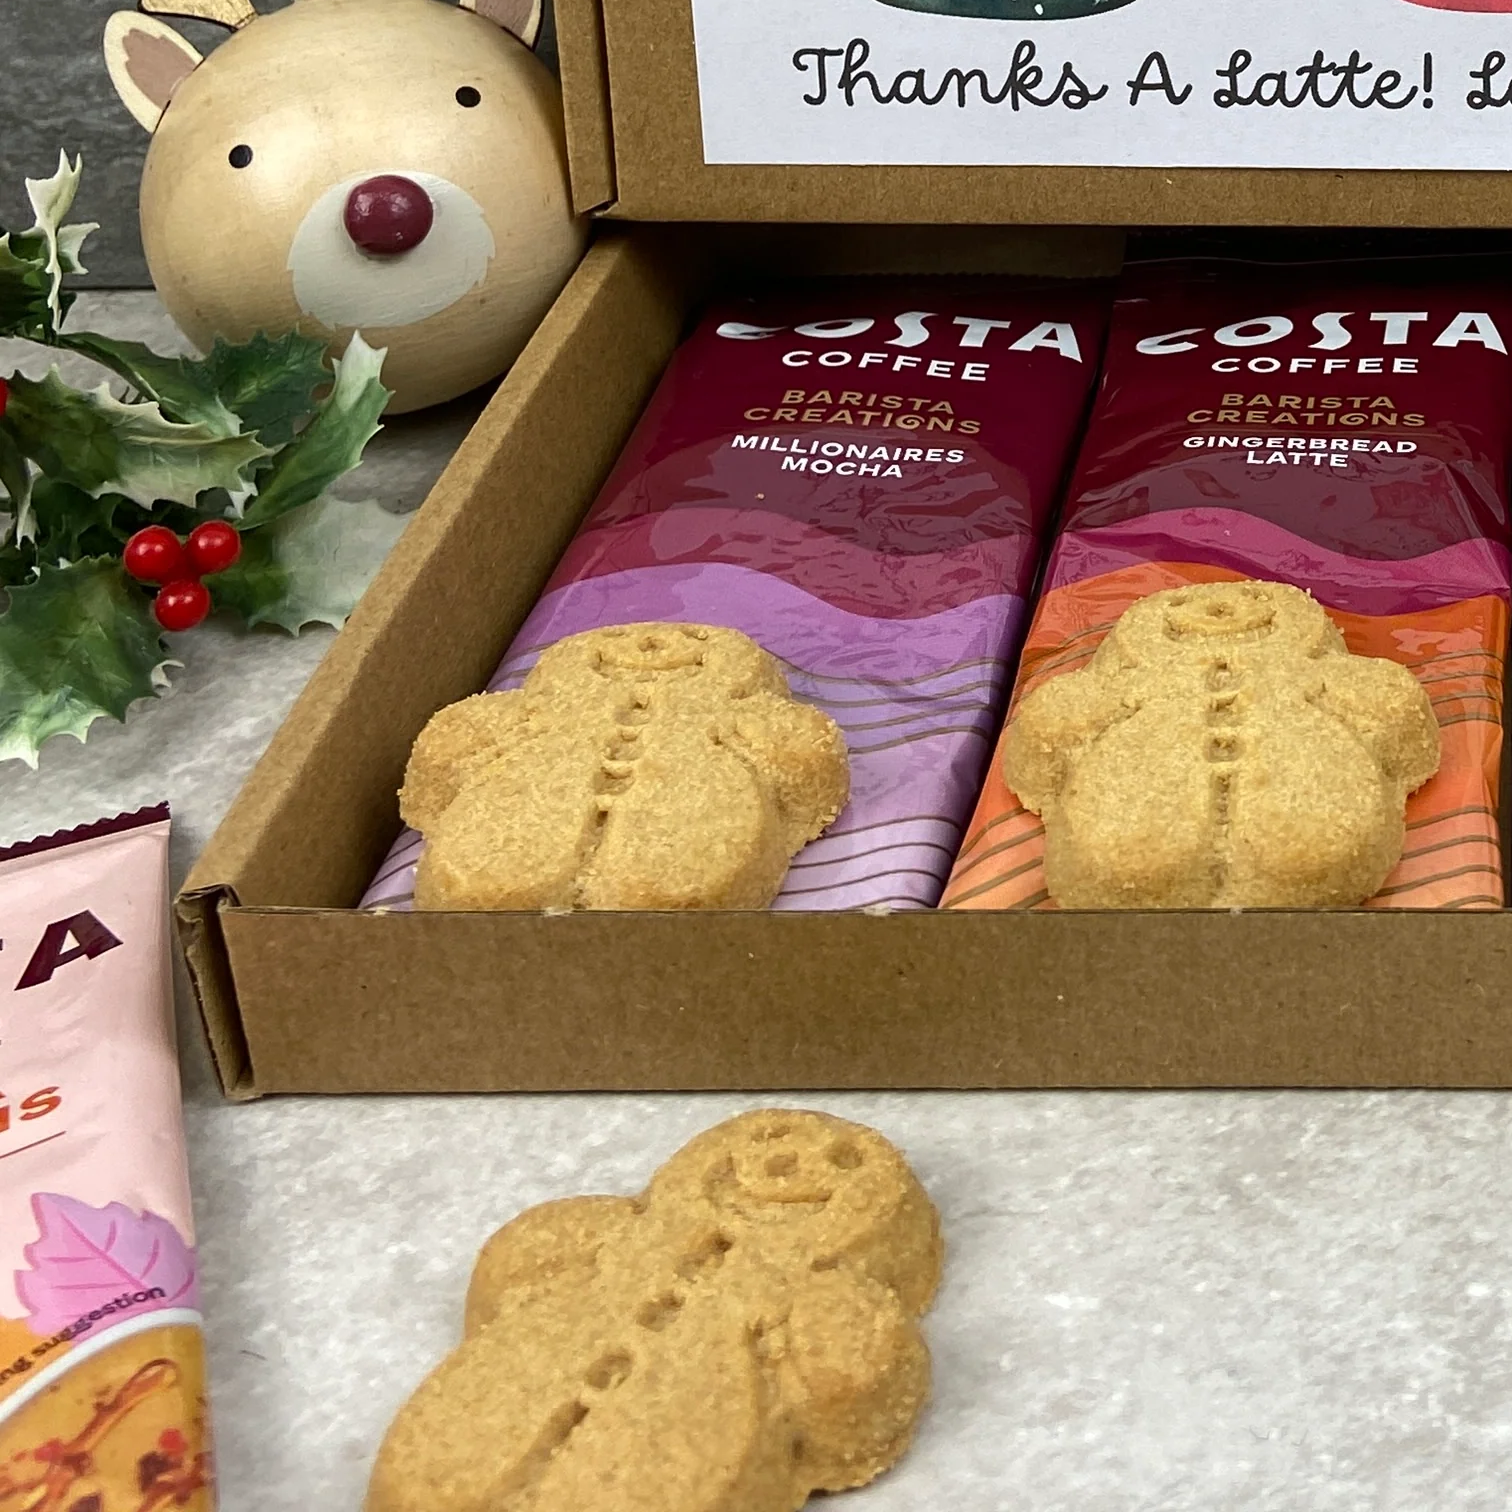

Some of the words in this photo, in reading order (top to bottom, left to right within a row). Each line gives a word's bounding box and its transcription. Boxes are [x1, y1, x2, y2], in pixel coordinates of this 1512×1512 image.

[792, 38, 1109, 111] Thanks
[1126, 50, 1192, 107] A
[1213, 49, 1434, 111] Latte!
[716, 311, 1083, 363] COSTA
[1135, 311, 1508, 356] COSTA
[782, 350, 990, 382] COFFEE
[1211, 357, 1419, 374] COFFEE
[782, 389, 955, 415] BARISTA
[1221, 393, 1395, 409] BARISTA
[743, 407, 982, 434] CREATIONS
[1186, 409, 1426, 427] CREATIONS
[731, 434, 965, 463] MILLIONAIRES
[1183, 436, 1418, 454] GINGERBREAD
[781, 457, 903, 478] MOCHA
[1246, 451, 1349, 467] LATTE
[31, 1286, 166, 1357] suggestion
